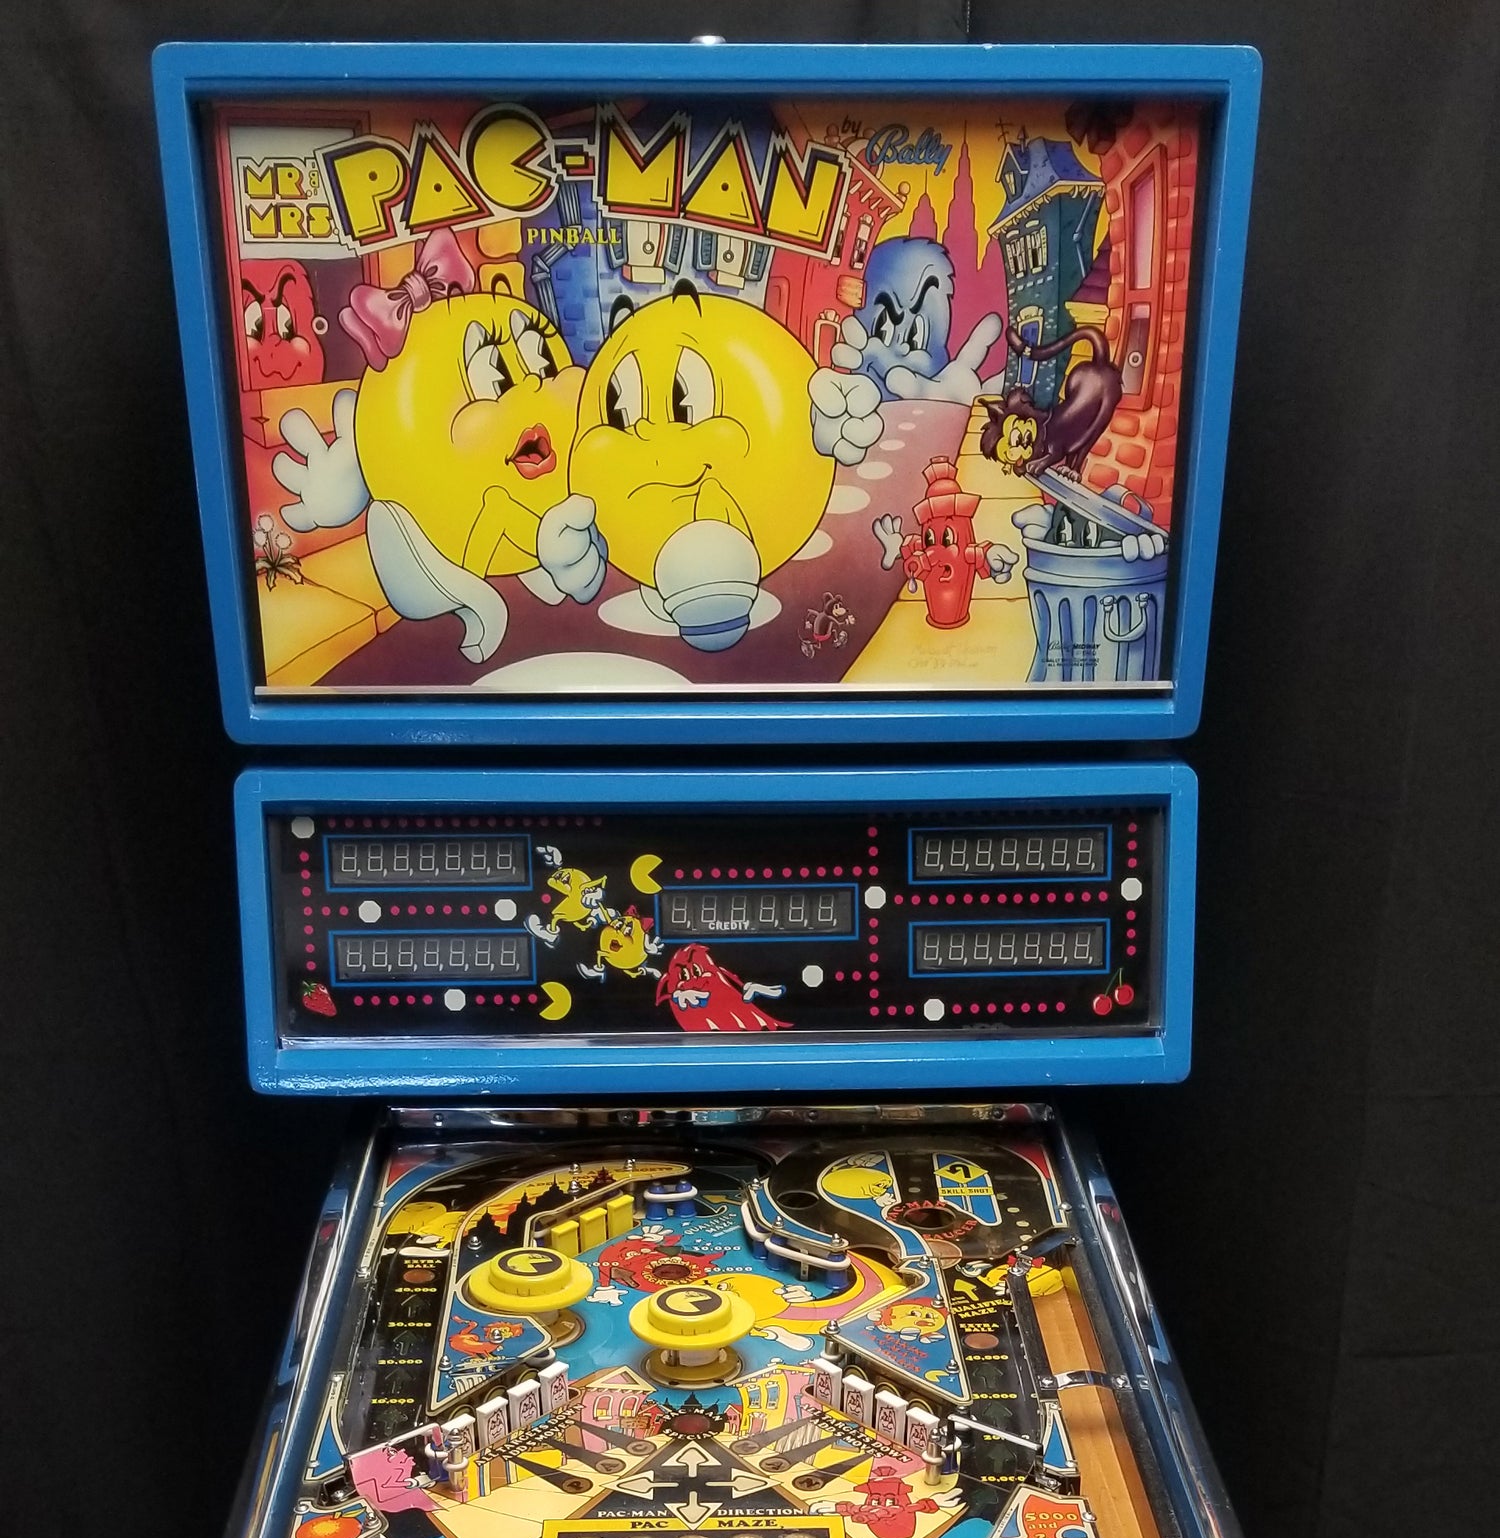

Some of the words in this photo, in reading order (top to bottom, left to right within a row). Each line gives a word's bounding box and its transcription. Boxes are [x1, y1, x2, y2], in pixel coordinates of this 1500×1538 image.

[841, 116, 863, 135] by
[865, 122, 953, 176] Bally
[322, 106, 850, 254] PAC-MAN
[526, 227, 623, 246] PINBALL
[708, 921, 750, 931] CREDIT
[958, 1307, 998, 1319] MAZE
[475, 1451, 500, 1467] ALL
[498, 1423, 550, 1454] TARGETS
[547, 1403, 587, 1426] DOWN
[502, 1444, 528, 1461] ADD
[534, 1418, 577, 1442] MOVES
[662, 1428, 719, 1440] SPECIAL
[810, 1417, 837, 1433] ADD
[842, 1436, 885, 1459] MOVES
[821, 1413, 874, 1443] TARGETS
[871, 1440, 914, 1463] DOWN
[596, 1509, 668, 1518] PAC-MAN
[717, 1508, 804, 1517] DIRECTION
[1025, 1512, 1078, 1522] 5000
[630, 1520, 669, 1529] PAC
[718, 1518, 779, 1529] MAZE
[1028, 1522, 1058, 1530] and
